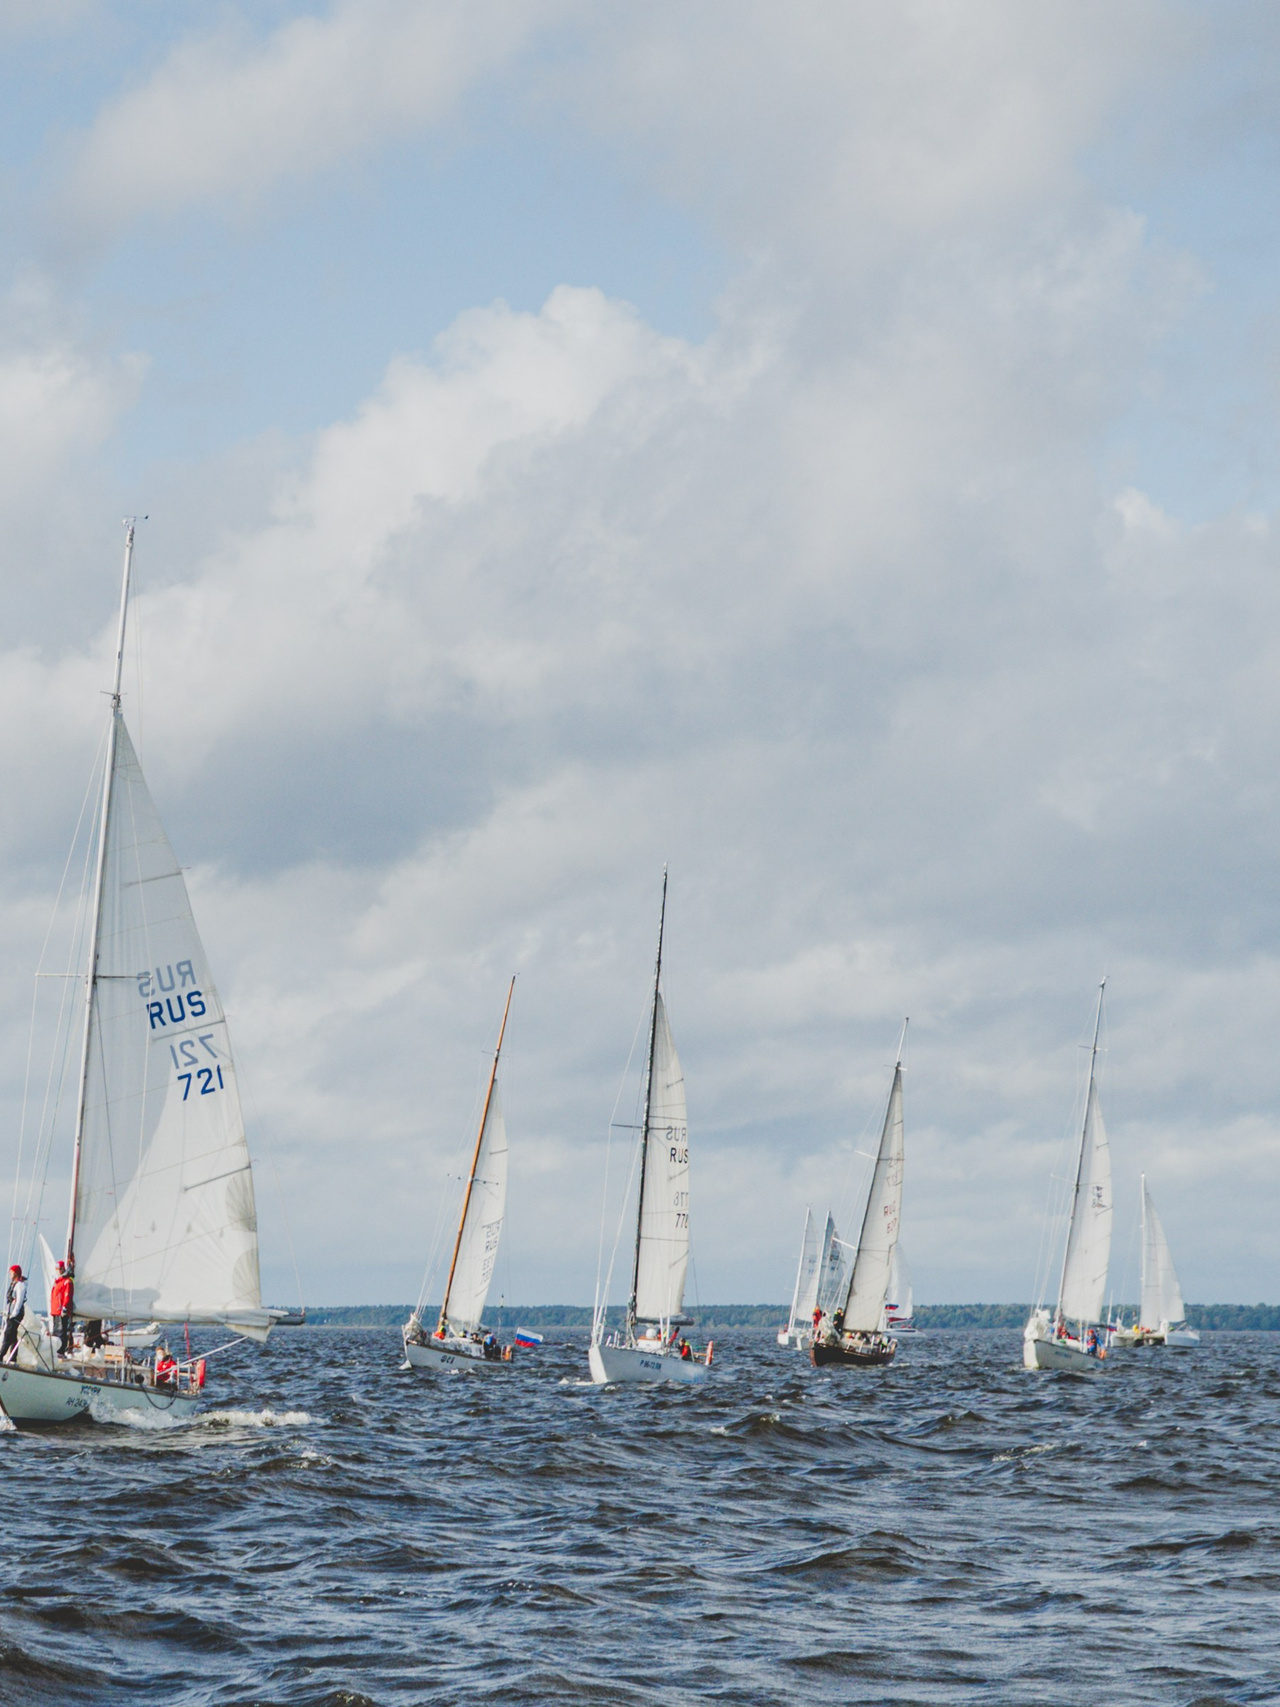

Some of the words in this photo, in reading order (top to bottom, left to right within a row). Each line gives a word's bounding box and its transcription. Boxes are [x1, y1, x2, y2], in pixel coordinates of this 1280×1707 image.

[146, 990, 206, 1030] RUS
[177, 1064, 224, 1101] 721
[669, 1147, 689, 1163] RUS
